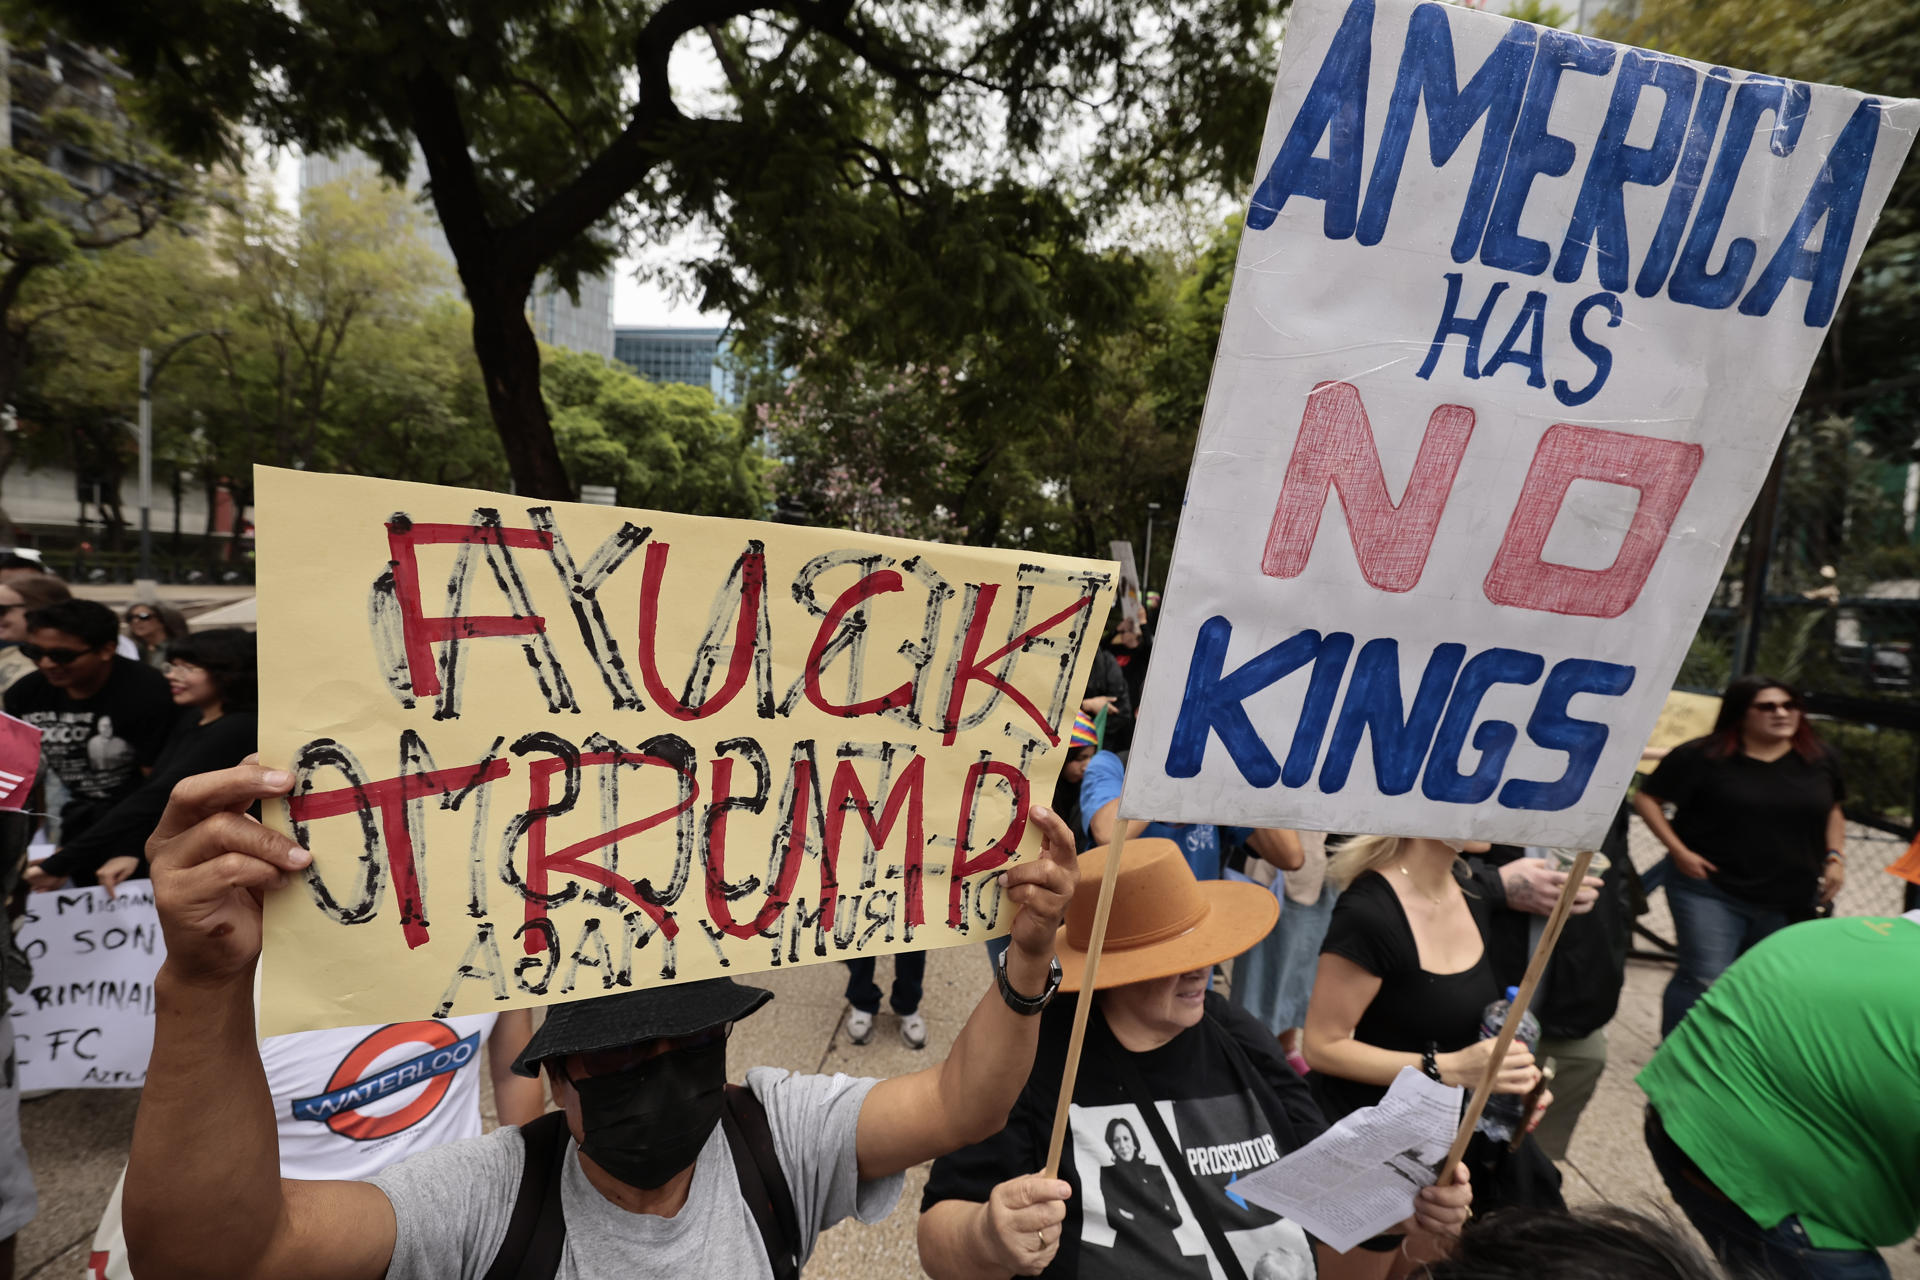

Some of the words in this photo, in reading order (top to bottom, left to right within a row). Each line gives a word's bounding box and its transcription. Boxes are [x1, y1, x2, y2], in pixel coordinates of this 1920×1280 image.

[1247, 0, 1882, 328] AMERICA
[1416, 272, 1623, 407] HAS
[1261, 379, 1704, 619] NO
[384, 523, 1061, 746] FUCK
[1165, 615, 1636, 811] KINGS
[73, 924, 155, 955] SON
[289, 752, 1030, 954] TRUMP
[306, 1043, 472, 1116] WATERLOO
[1185, 1133, 1280, 1176] PROSECUTOR
